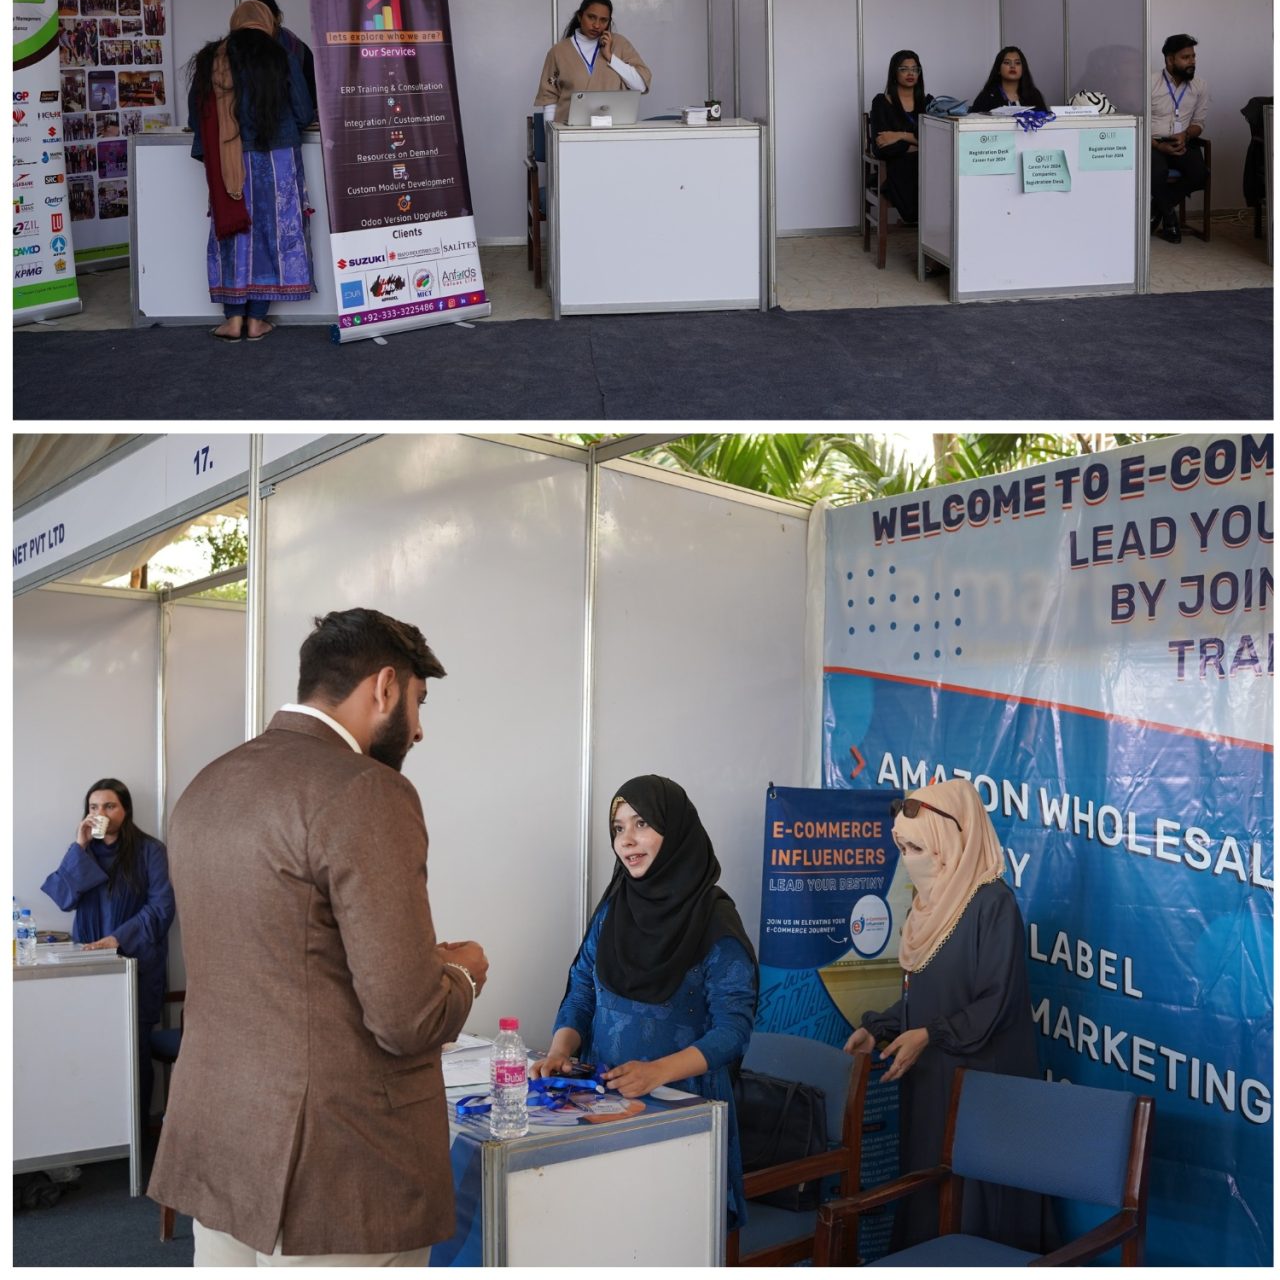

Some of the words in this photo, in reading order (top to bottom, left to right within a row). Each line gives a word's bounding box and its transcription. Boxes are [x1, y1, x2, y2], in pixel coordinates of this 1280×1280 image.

[329, 32, 347, 41] lets
[350, 32, 384, 42] explore
[387, 31, 405, 41] who
[407, 32, 418, 40] we
[422, 31, 441, 40] are?
[361, 48, 378, 58] Our
[380, 47, 416, 56] Services
[340, 86, 355, 94] ERP
[359, 85, 389, 94] Training
[390, 84, 396, 92] &
[398, 82, 443, 91] Consultation
[347, 184, 376, 195] Custom
[379, 181, 405, 192] Module
[408, 177, 455, 189] Development
[392, 228, 423, 239] Clients
[349, 254, 385, 267] SUZUKI
[15, 267, 42, 279] KPMG
[193, 446, 213, 475] 17.
[872, 475, 1046, 546] WELCOME
[1055, 462, 1110, 510] TO
[30, 532, 46, 558] PVT
[49, 523, 65, 548] LTD
[1111, 578, 1166, 625] BY
[772, 821, 882, 839] E-COMMERCE
[771, 848, 886, 866] INFLUENCERS
[769, 878, 804, 892] LEAD
[807, 878, 836, 891] YOUR
[839, 877, 885, 890] DESTINY
[1029, 922, 1143, 1000] LABEL
[1031, 997, 1272, 1124] MARKETING
